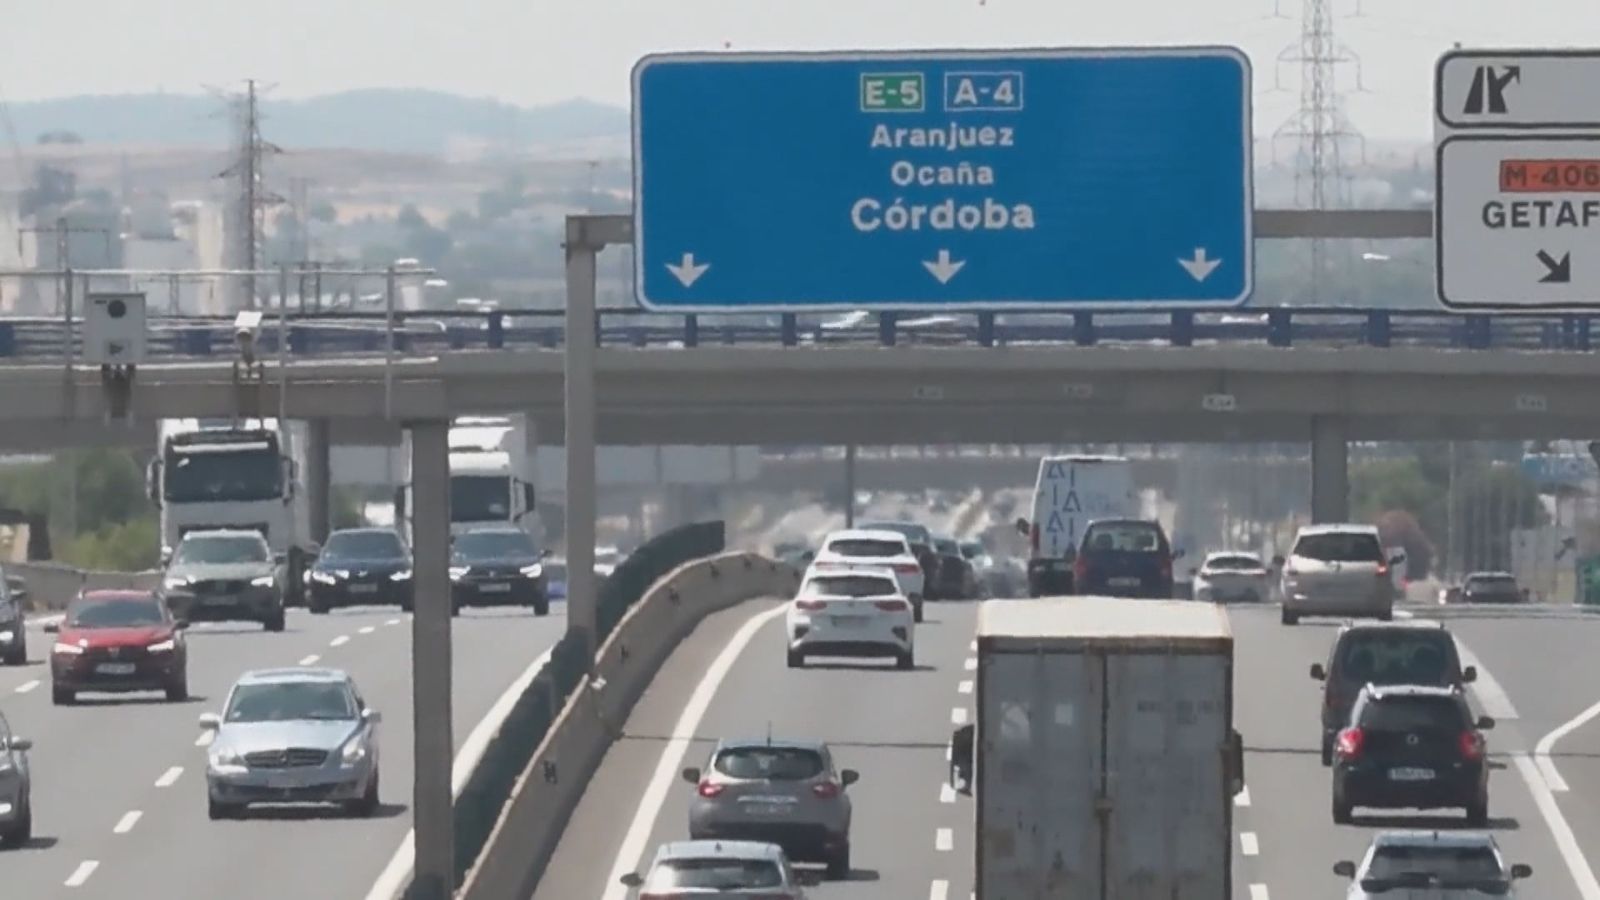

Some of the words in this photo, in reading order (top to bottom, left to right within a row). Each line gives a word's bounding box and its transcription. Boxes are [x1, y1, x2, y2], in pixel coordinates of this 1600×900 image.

[865, 80, 920, 106] E-5
[953, 78, 1015, 105] A-4
[871, 121, 1014, 151] Aranjuez
[891, 161, 994, 186] Ocaña
[1505, 164, 1600, 187] M-406
[851, 197, 1035, 232] Córdoba
